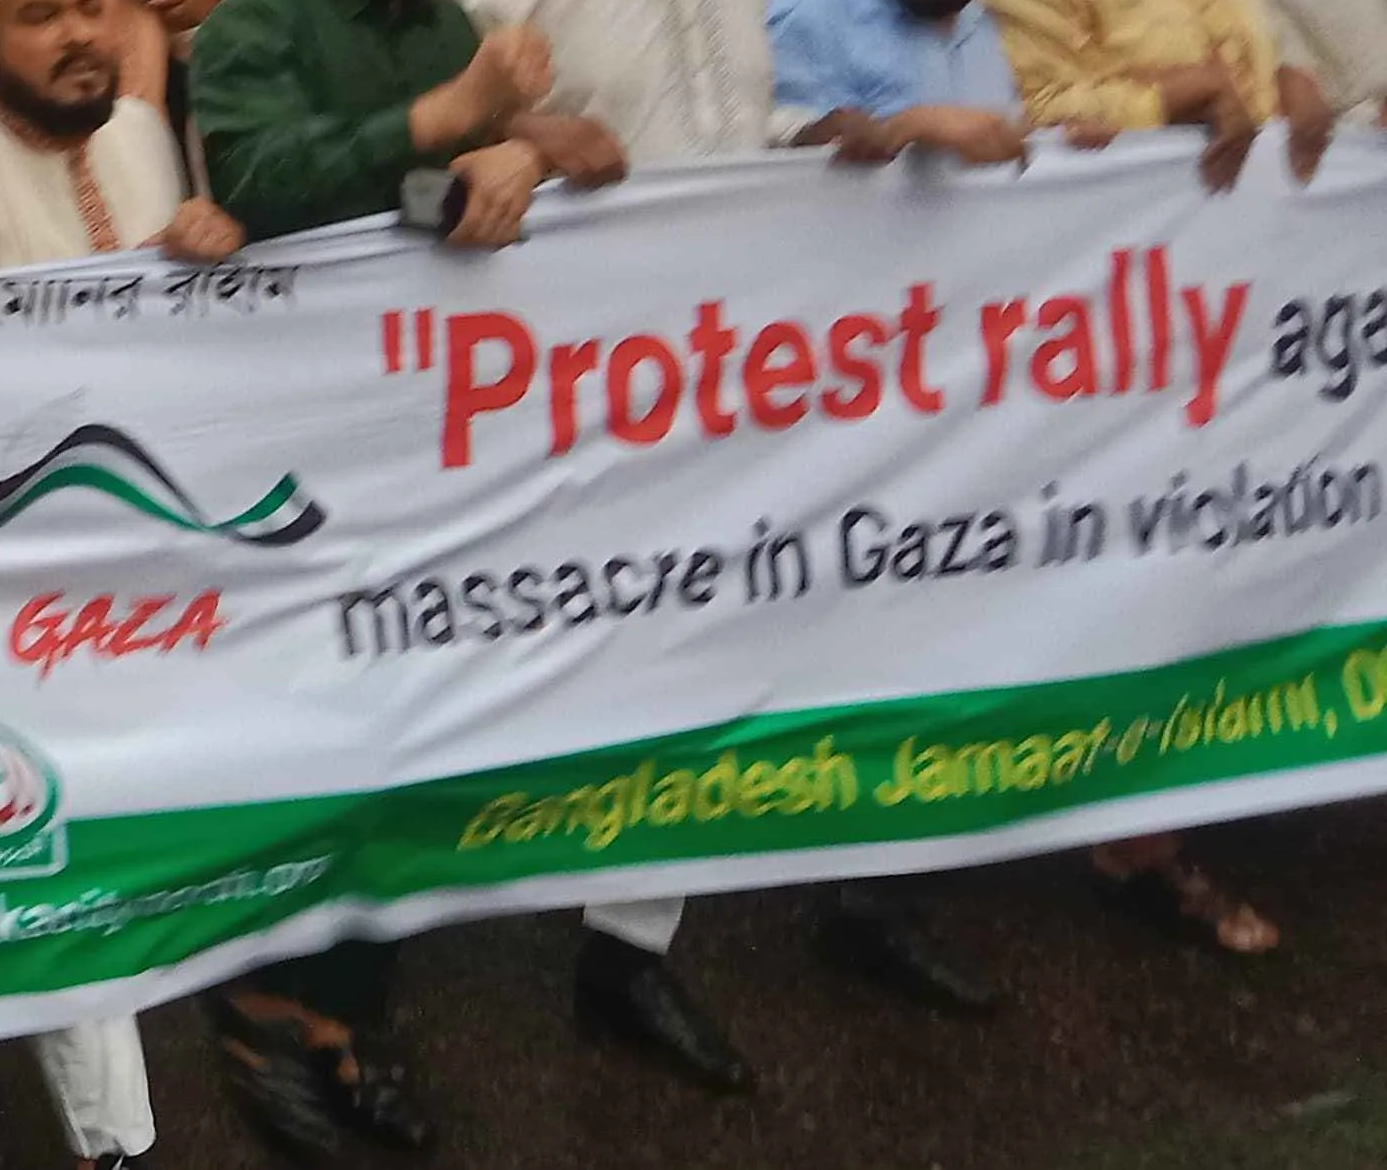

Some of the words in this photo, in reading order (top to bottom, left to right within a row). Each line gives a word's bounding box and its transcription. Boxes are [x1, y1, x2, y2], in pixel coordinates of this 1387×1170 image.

[379, 281, 946, 470] "Protest
[978, 244, 1252, 427] rally
[341, 549, 725, 656] massacre
[744, 516, 810, 605] in
[840, 504, 1020, 588] Gaza
[1035, 480, 1108, 570] in
[1129, 452, 1385, 556] violation
[8, 587, 228, 687] GAZA
[456, 734, 859, 851] Bangladesh
